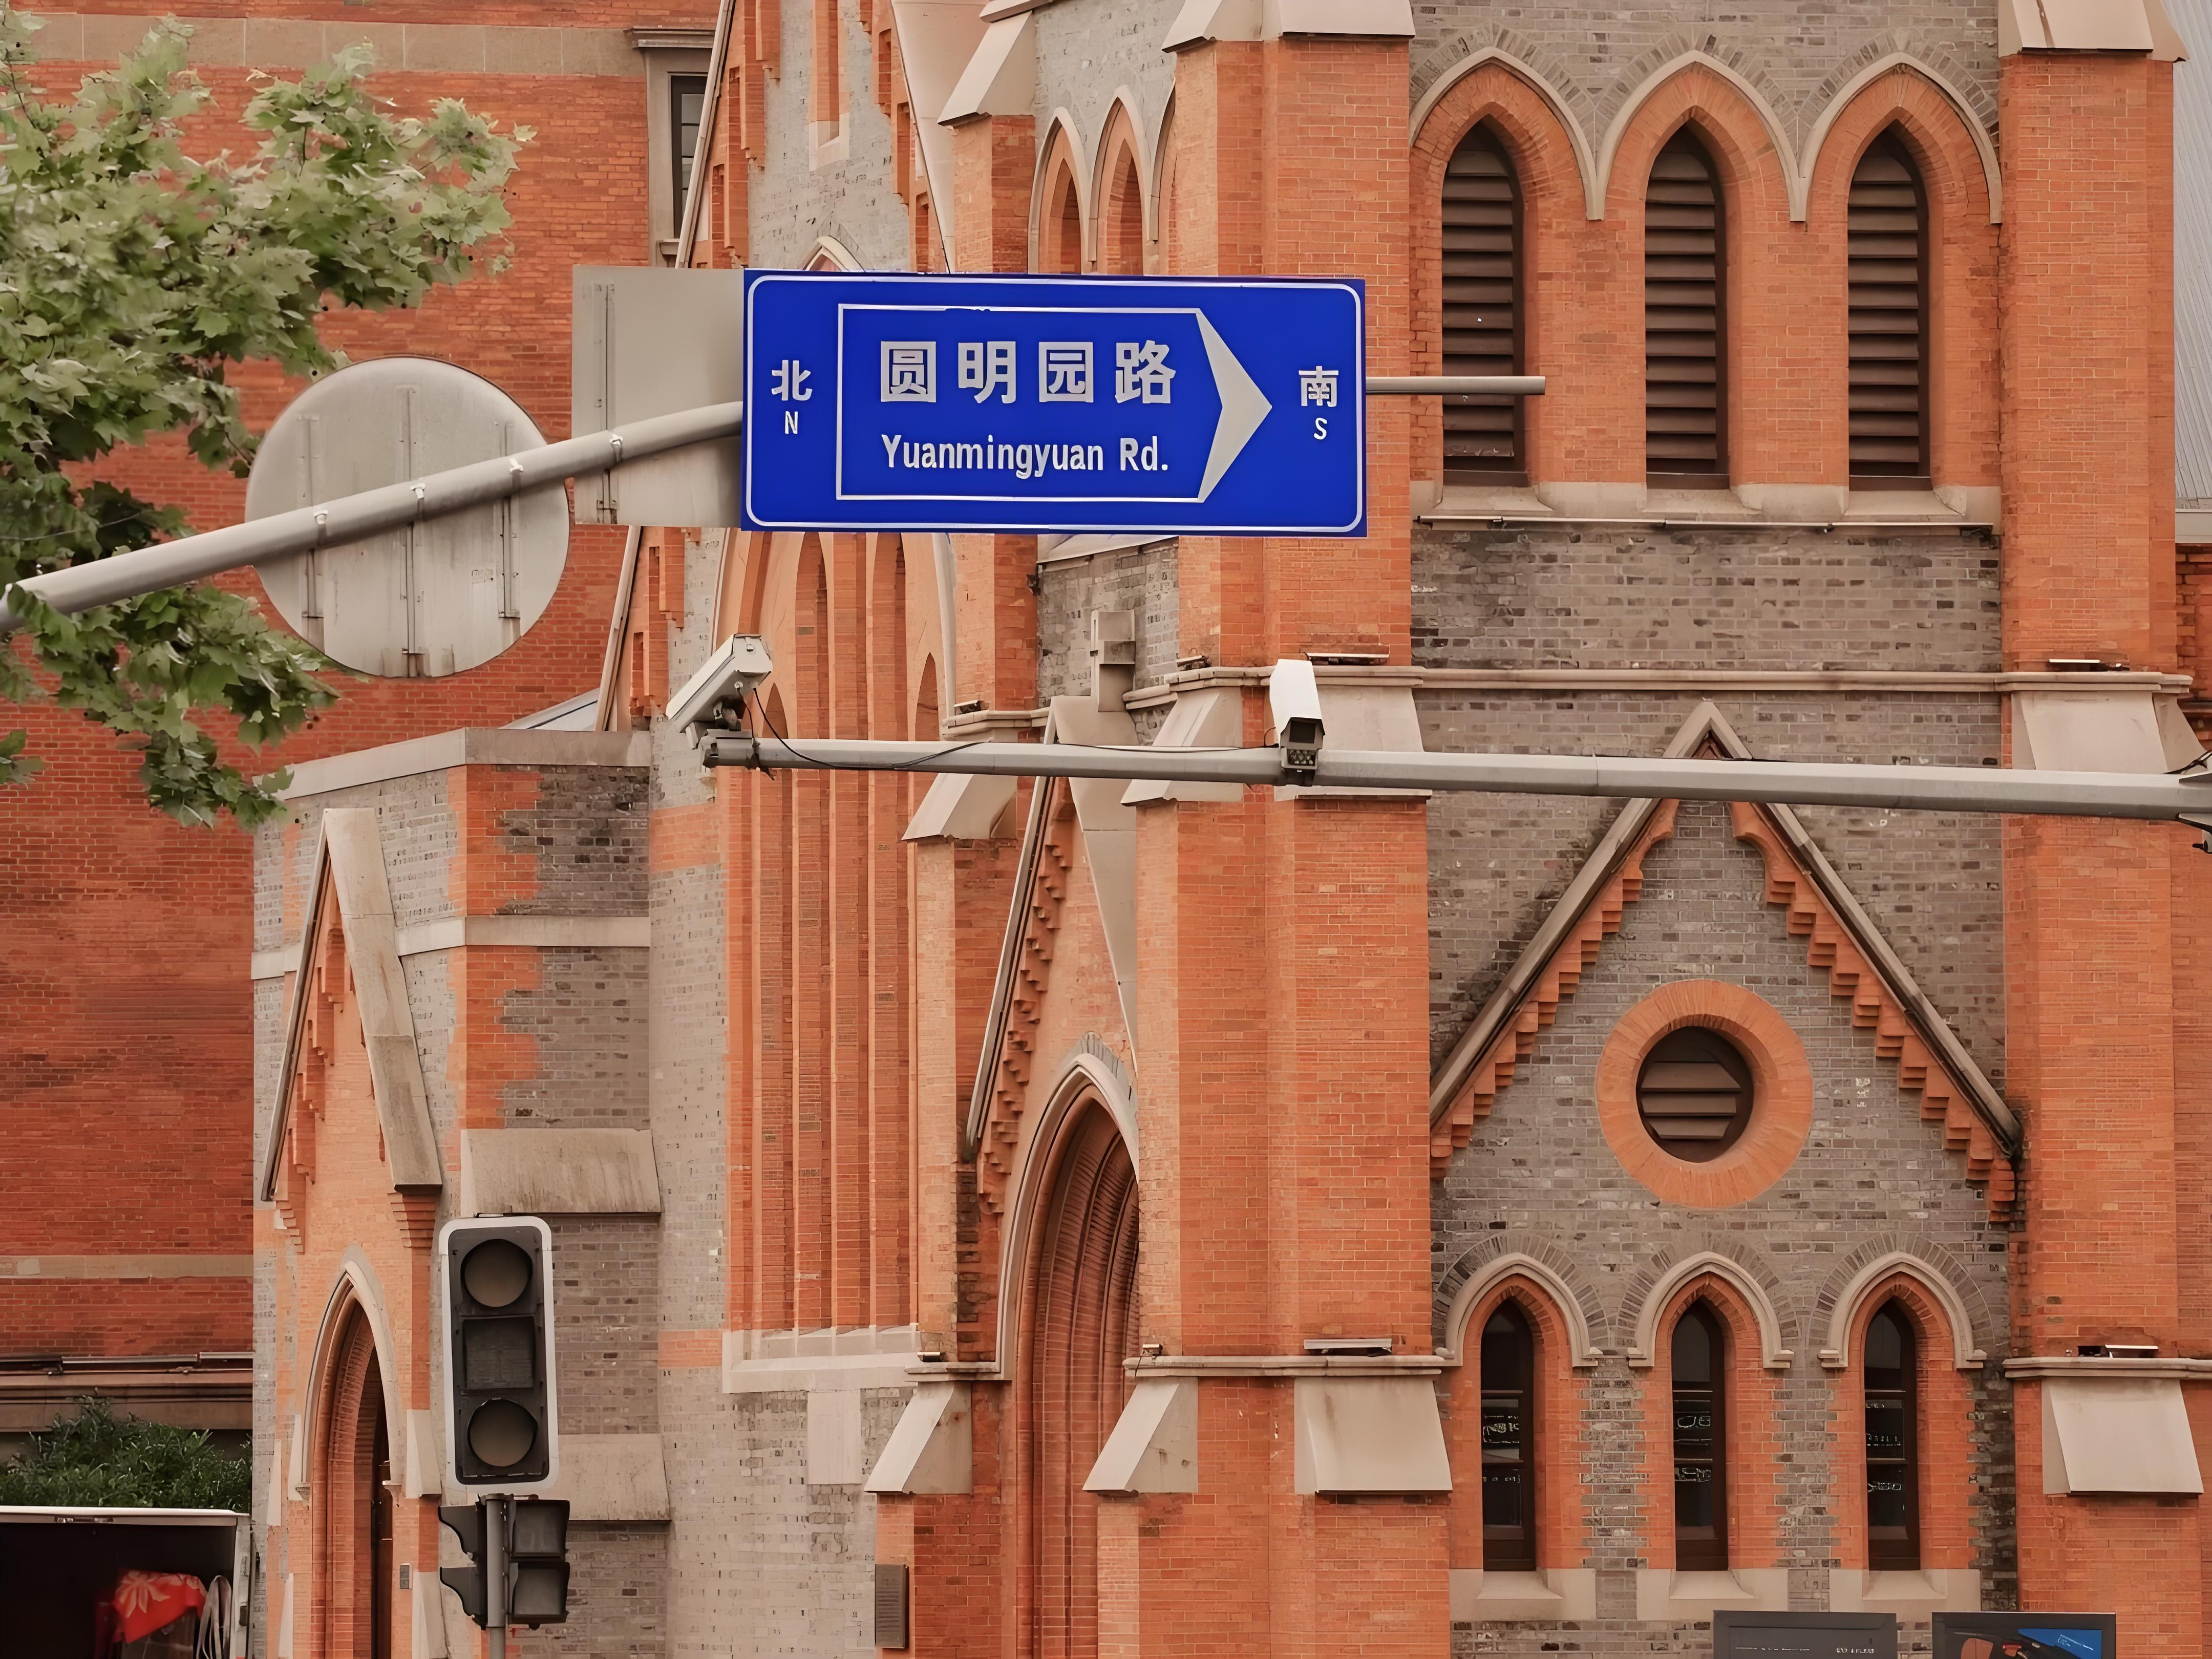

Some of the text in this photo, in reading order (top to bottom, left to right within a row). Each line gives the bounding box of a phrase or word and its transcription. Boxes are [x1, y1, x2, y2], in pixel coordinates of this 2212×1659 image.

[771, 359, 813, 401] 北
[880, 339, 1176, 404] 圆明园路
[1298, 366, 1339, 408] 南
[784, 411, 798, 434] N
[1313, 417, 1328, 440] S
[881, 434, 1168, 479] Yuanmingyuan Rd.
